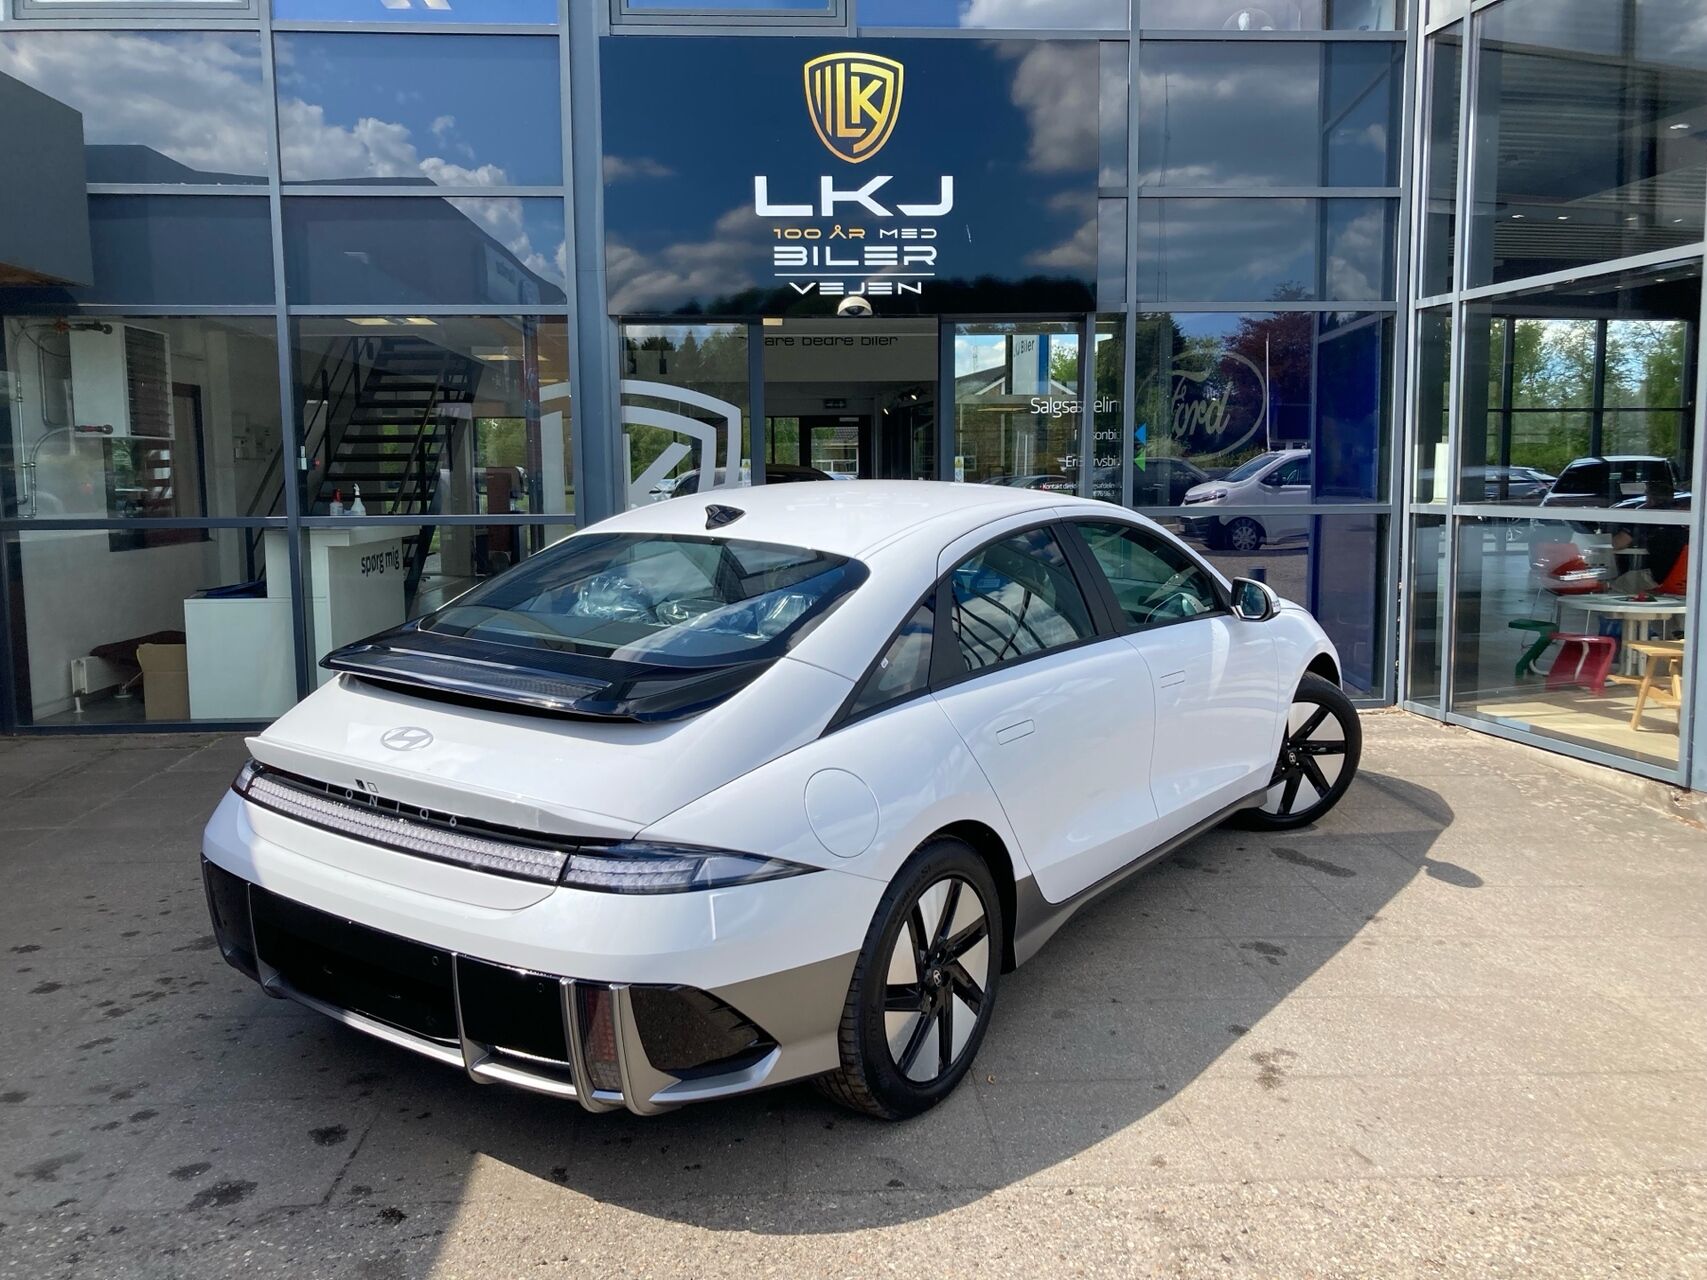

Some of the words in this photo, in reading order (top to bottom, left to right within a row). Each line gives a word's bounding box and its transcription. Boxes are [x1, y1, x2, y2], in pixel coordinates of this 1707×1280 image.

[754, 175, 954, 217] LKJ
[773, 228, 822, 239] 100
[829, 224, 866, 239] ÅR
[879, 228, 938, 239] MED
[774, 246, 938, 266] BILER
[788, 282, 923, 295] VEJEN
[801, 336, 854, 346] bedre
[860, 336, 899, 346] biler
[1160, 369, 1233, 441] Ford
[361, 552, 384, 577] spørg
[385, 545, 400, 570] mig
[325, 782, 429, 820] IONIQ
[448, 815, 457, 827] 6
